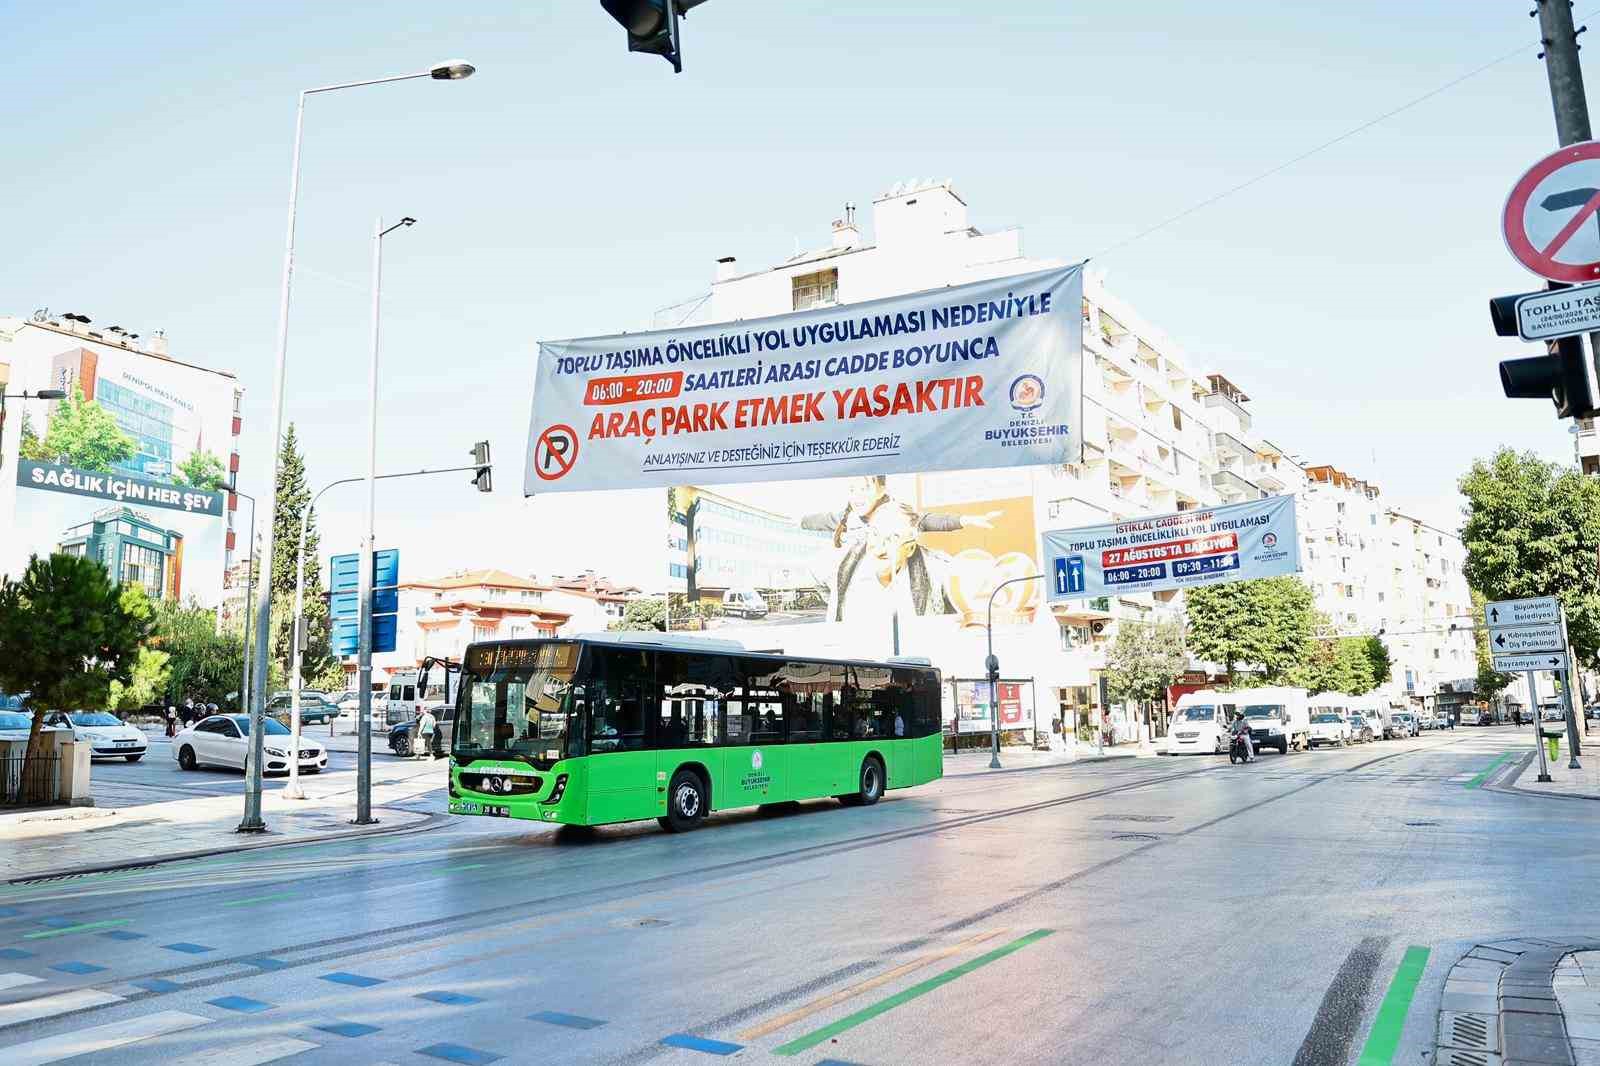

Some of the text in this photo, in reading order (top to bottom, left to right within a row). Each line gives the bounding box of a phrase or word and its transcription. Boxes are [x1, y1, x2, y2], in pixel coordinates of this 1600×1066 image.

[1524, 302, 1570, 316] TOPLU
[556, 292, 1051, 375] TOPLU TAŞIMA ÖNCELİKLİ YOL UYGULAMASI NEDENİYLE
[591, 380, 623, 401] 06:00
[636, 377, 673, 395] 20:00
[684, 360, 762, 392] SAATLERİ
[764, 360, 819, 384] ARASI
[824, 350, 889, 377] CADDE
[892, 336, 1000, 369] BOYUNCA
[588, 375, 986, 445] ARAÇ PARK ETMEK YASAKTIR
[644, 432, 901, 466] ANLAYIŞINIZ VE DESTEĞİNİZ İÇİN TEŞEKKÜR EDERİZ
[32, 465, 212, 512] SAĞLIK İÇİN HER ŞEY
[1070, 540, 1095, 552] TOPLU
[1097, 537, 1128, 550] TAŞIMA
[1192, 524, 1208, 535] YOL
[1210, 514, 1270, 532] UYGULAMASI
[1108, 551, 1120, 564] 27
[1124, 544, 1182, 562] AĞUSTOS'TA
[1108, 570, 1130, 582] 06:00
[1138, 566, 1160, 578] 20:00
